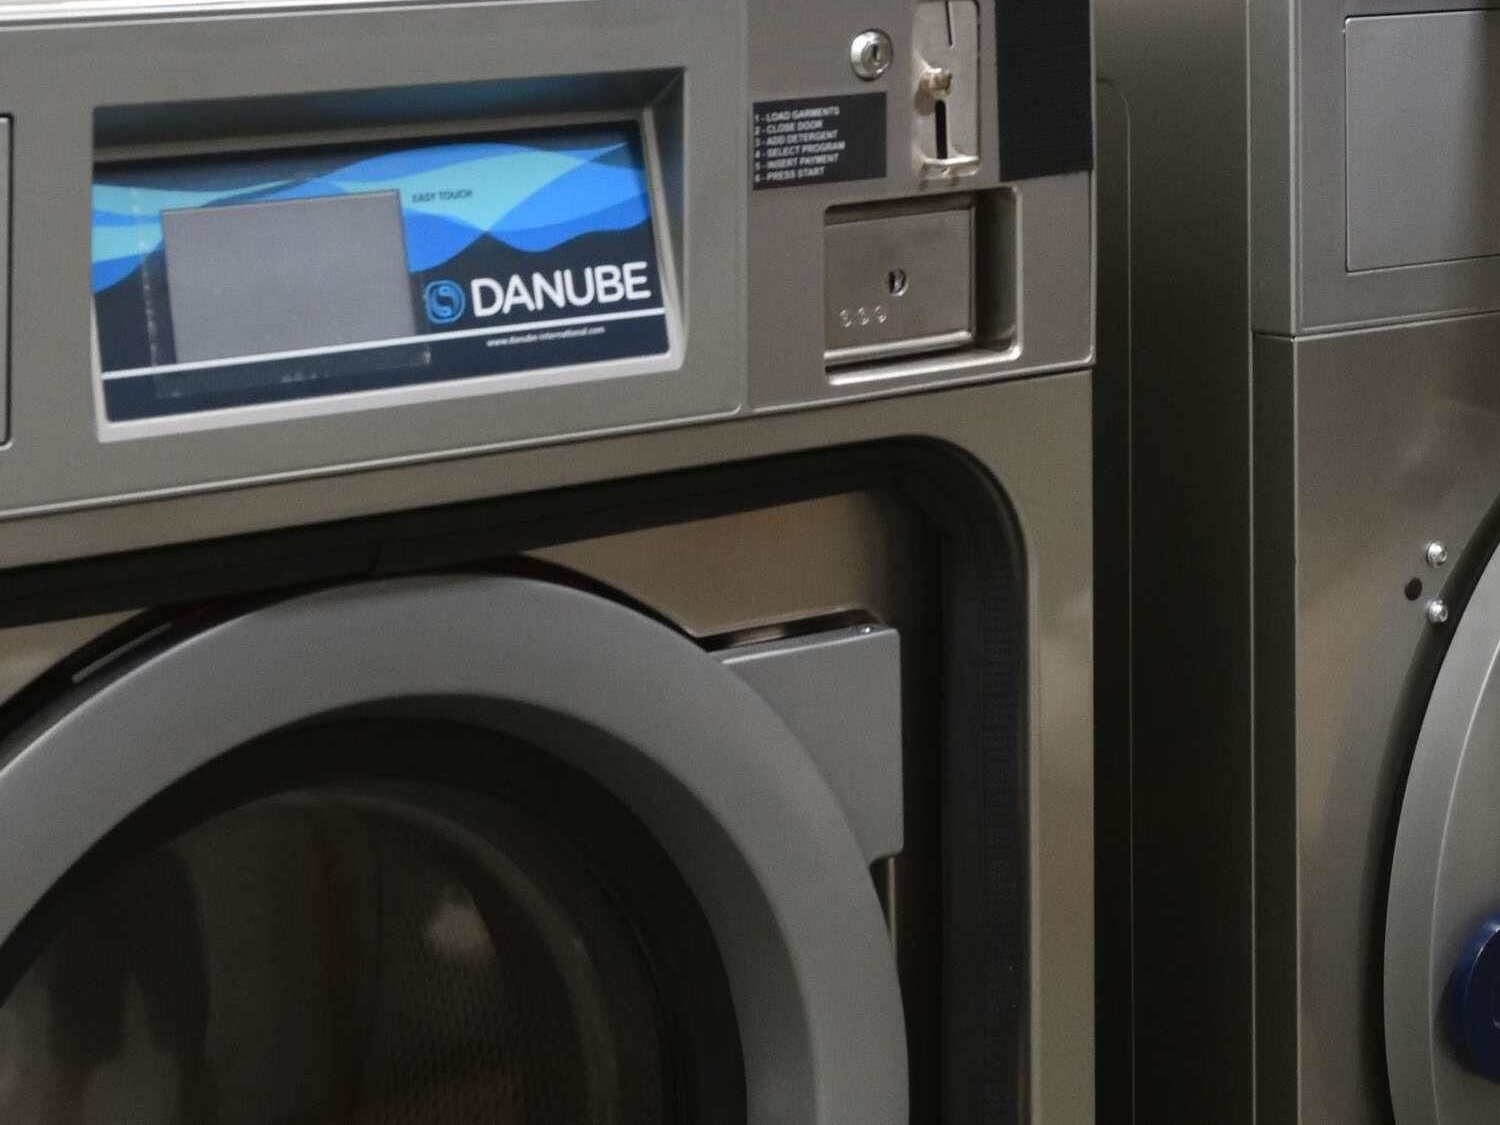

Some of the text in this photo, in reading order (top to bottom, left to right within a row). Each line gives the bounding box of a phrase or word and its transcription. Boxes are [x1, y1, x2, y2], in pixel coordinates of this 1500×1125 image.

[766, 110, 791, 122] LOAD
[411, 188, 473, 204] EASY TOUCH
[470, 260, 652, 318] DANUBE
